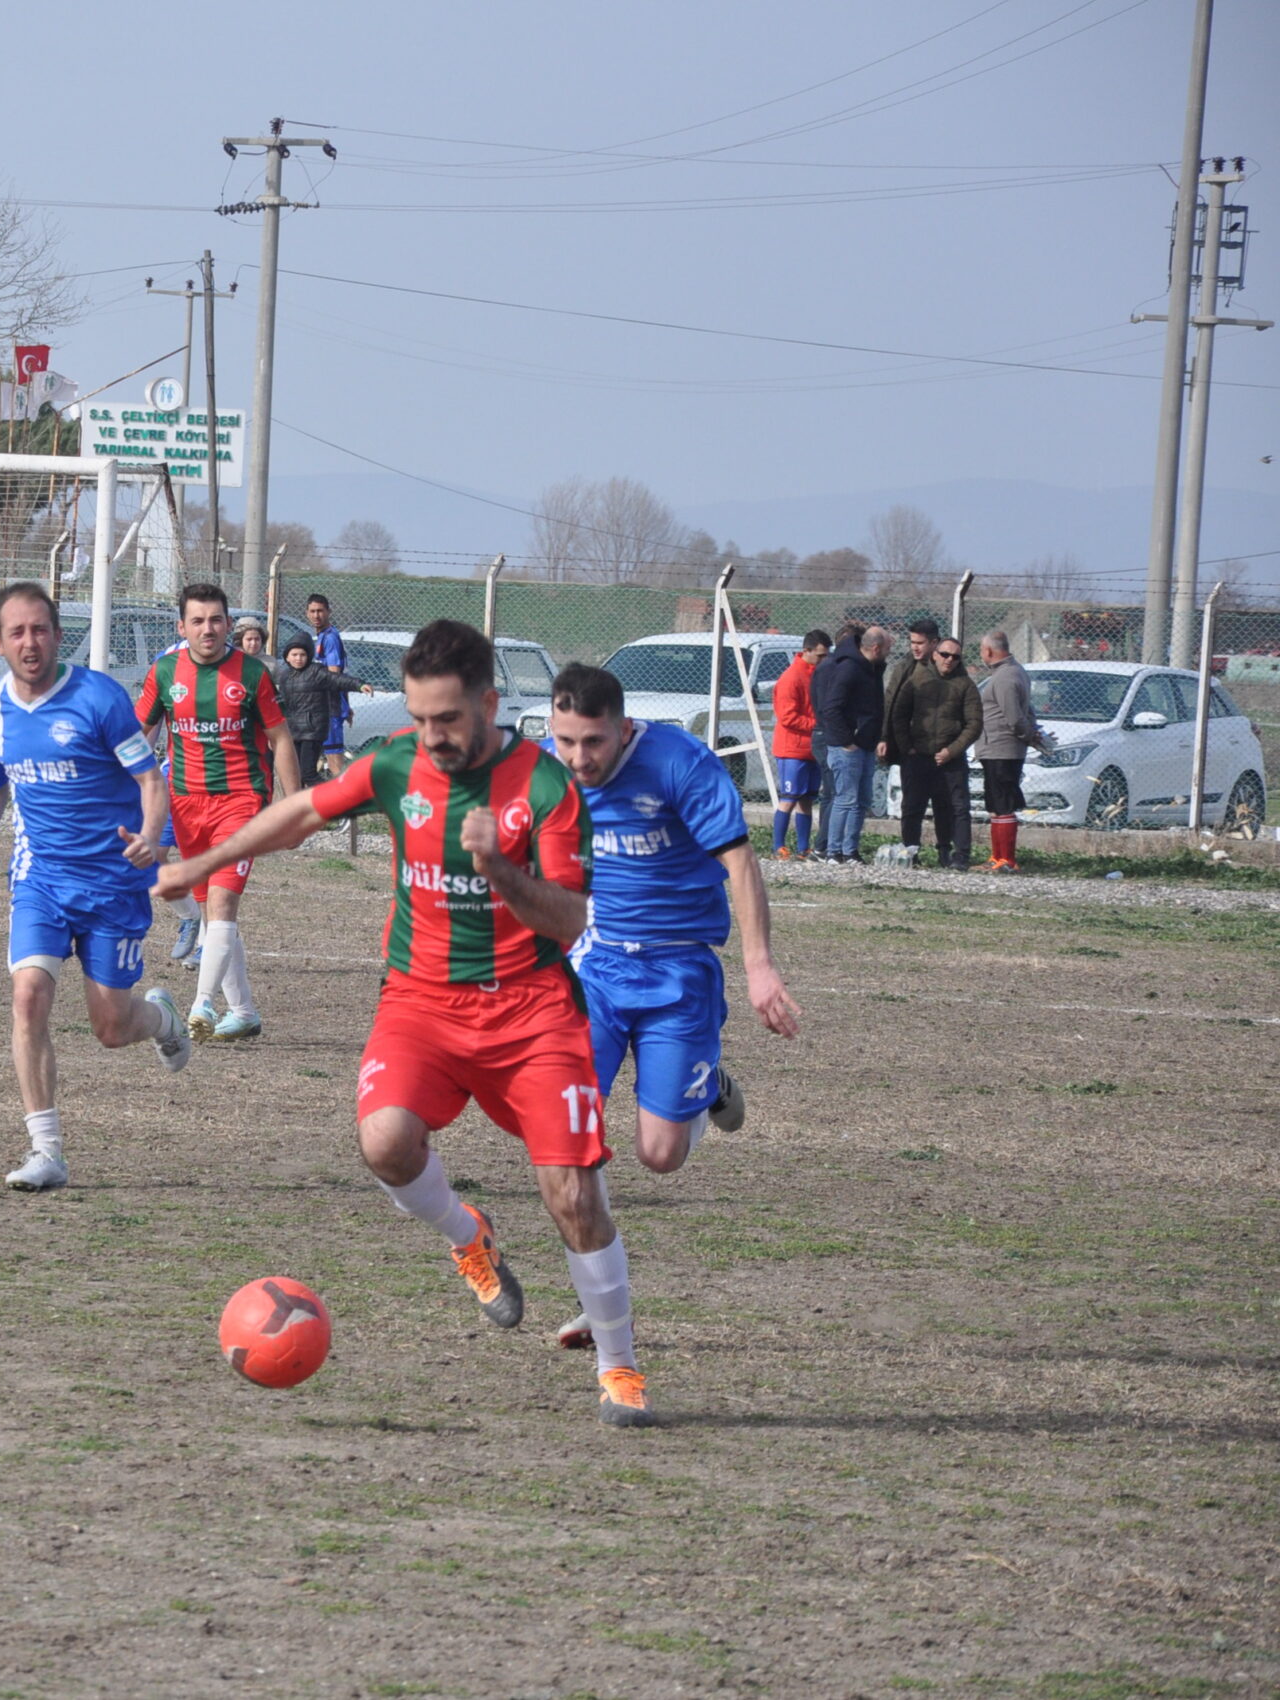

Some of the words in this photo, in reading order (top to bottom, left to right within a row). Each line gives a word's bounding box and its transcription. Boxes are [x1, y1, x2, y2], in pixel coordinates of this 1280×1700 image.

[89, 409, 114, 421] S.S.
[121, 410, 180, 427] ÇELTİKÇİ
[93, 443, 157, 458] TARIMSAL
[99, 426, 117, 439] VE
[123, 428, 166, 443] ÇEVRE
[176, 429, 231, 445] KÖYLRİ
[620, 826, 672, 857] YAPI
[402, 859, 536, 896] yükse
[116, 937, 144, 971] 10
[683, 1060, 711, 1100] 2
[561, 1084, 599, 1134] 17
